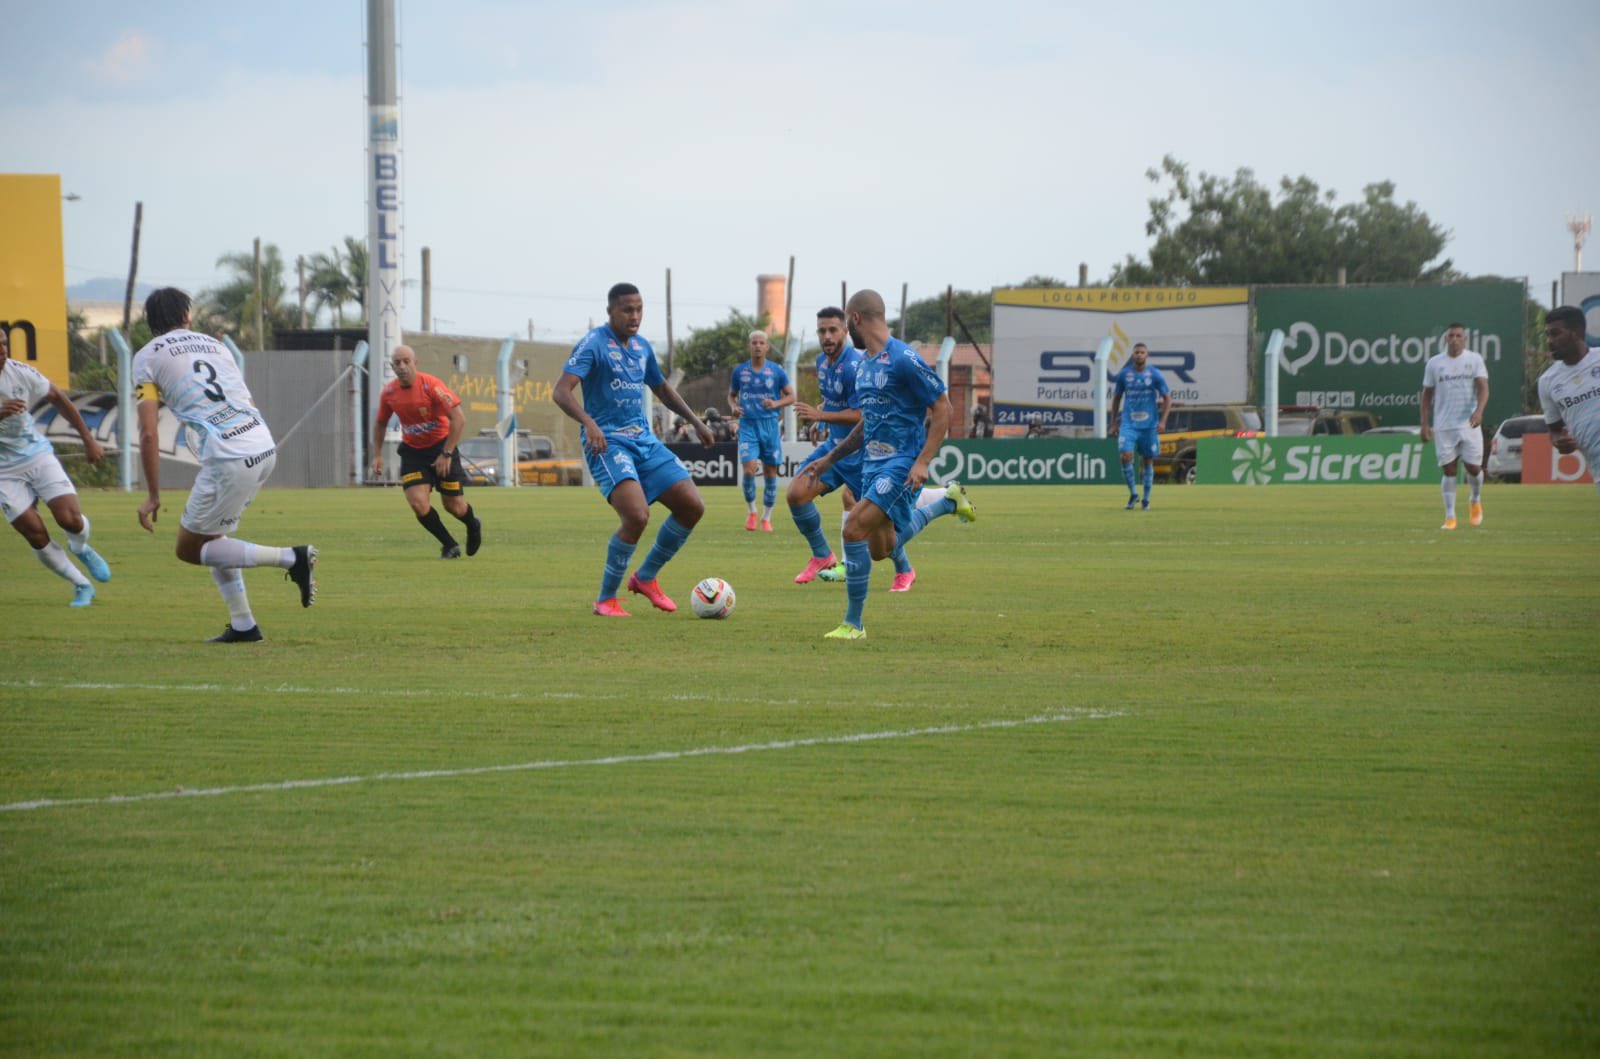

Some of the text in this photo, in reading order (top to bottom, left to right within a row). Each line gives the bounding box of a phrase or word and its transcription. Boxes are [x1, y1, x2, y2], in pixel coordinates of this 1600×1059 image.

[374, 153, 398, 269] BELL
[1042, 290, 1197, 302] LOCAL PROTEGIDO
[169, 343, 221, 358] GEROMEL
[193, 359, 226, 402] 3
[1037, 386, 1087, 400] Portaria
[998, 410, 1075, 423] 24 HORAS
[967, 452, 1106, 480] DoctorClin
[1283, 443, 1423, 481] Sicredi
